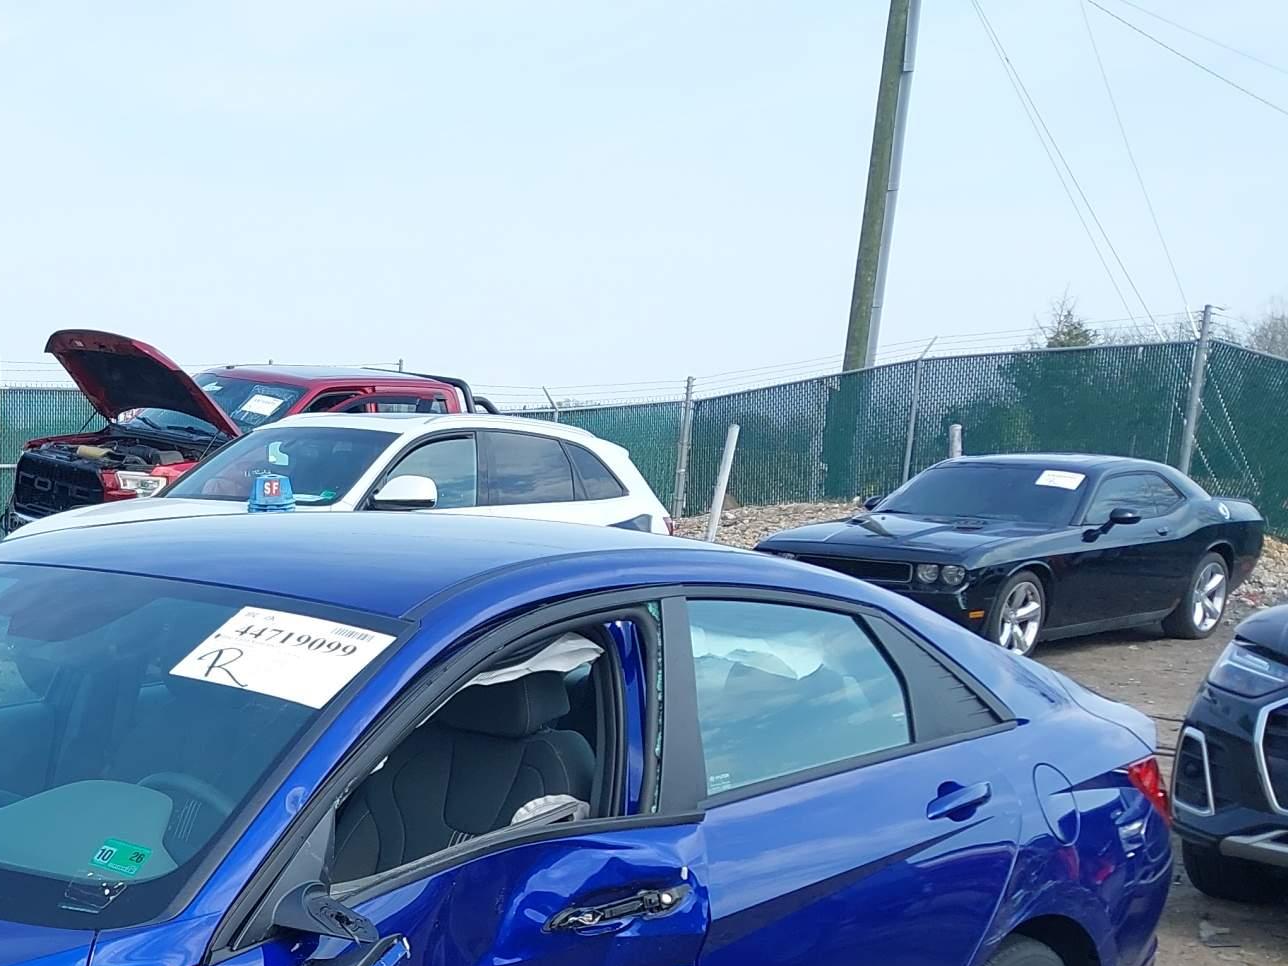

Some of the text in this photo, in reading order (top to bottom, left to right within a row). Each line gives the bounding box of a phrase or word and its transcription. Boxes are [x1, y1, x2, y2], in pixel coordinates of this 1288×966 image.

[264, 482, 279, 495] SF
[235, 624, 357, 657] 44719099
[197, 647, 249, 688] R
[97, 848, 113, 862] 10
